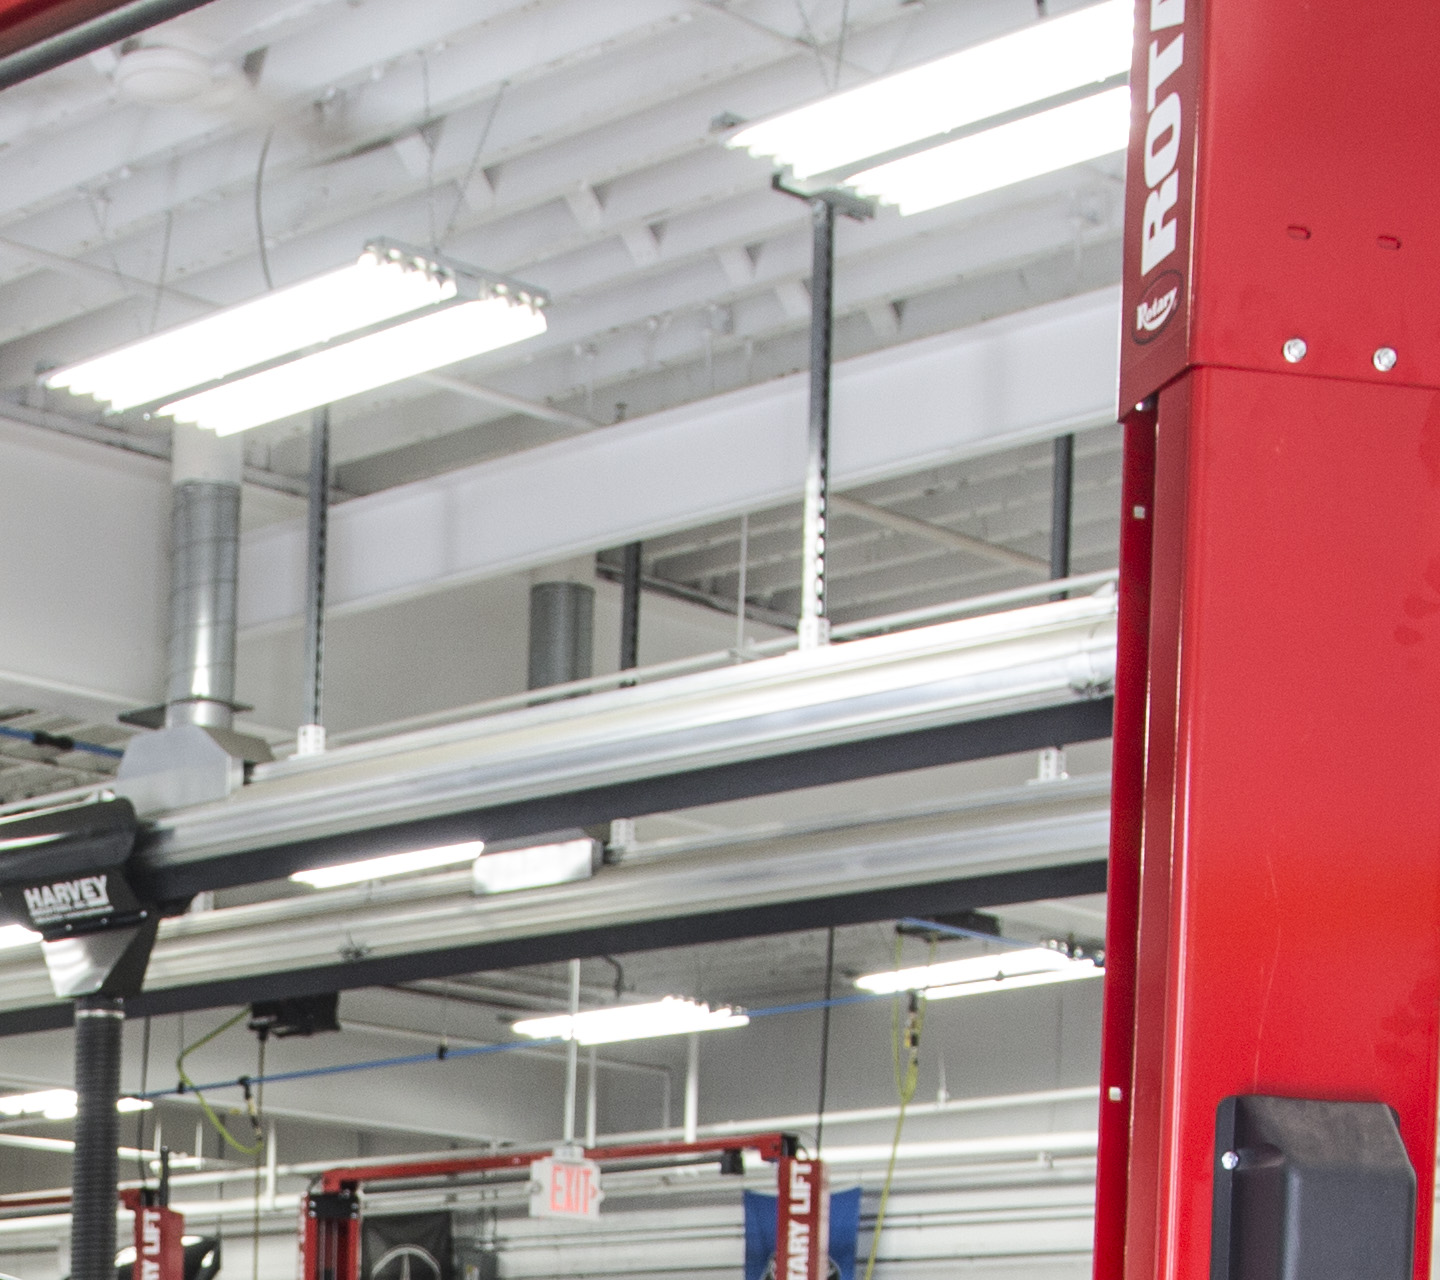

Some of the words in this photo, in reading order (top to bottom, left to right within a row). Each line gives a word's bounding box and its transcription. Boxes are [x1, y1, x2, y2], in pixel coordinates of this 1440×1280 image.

[1137, 286, 1178, 331] Rotary
[23, 874, 109, 911] HARVEY
[550, 1164, 592, 1215] EXIT
[788, 1160, 813, 1215] LIFT
[142, 1209, 161, 1255] LIFT
